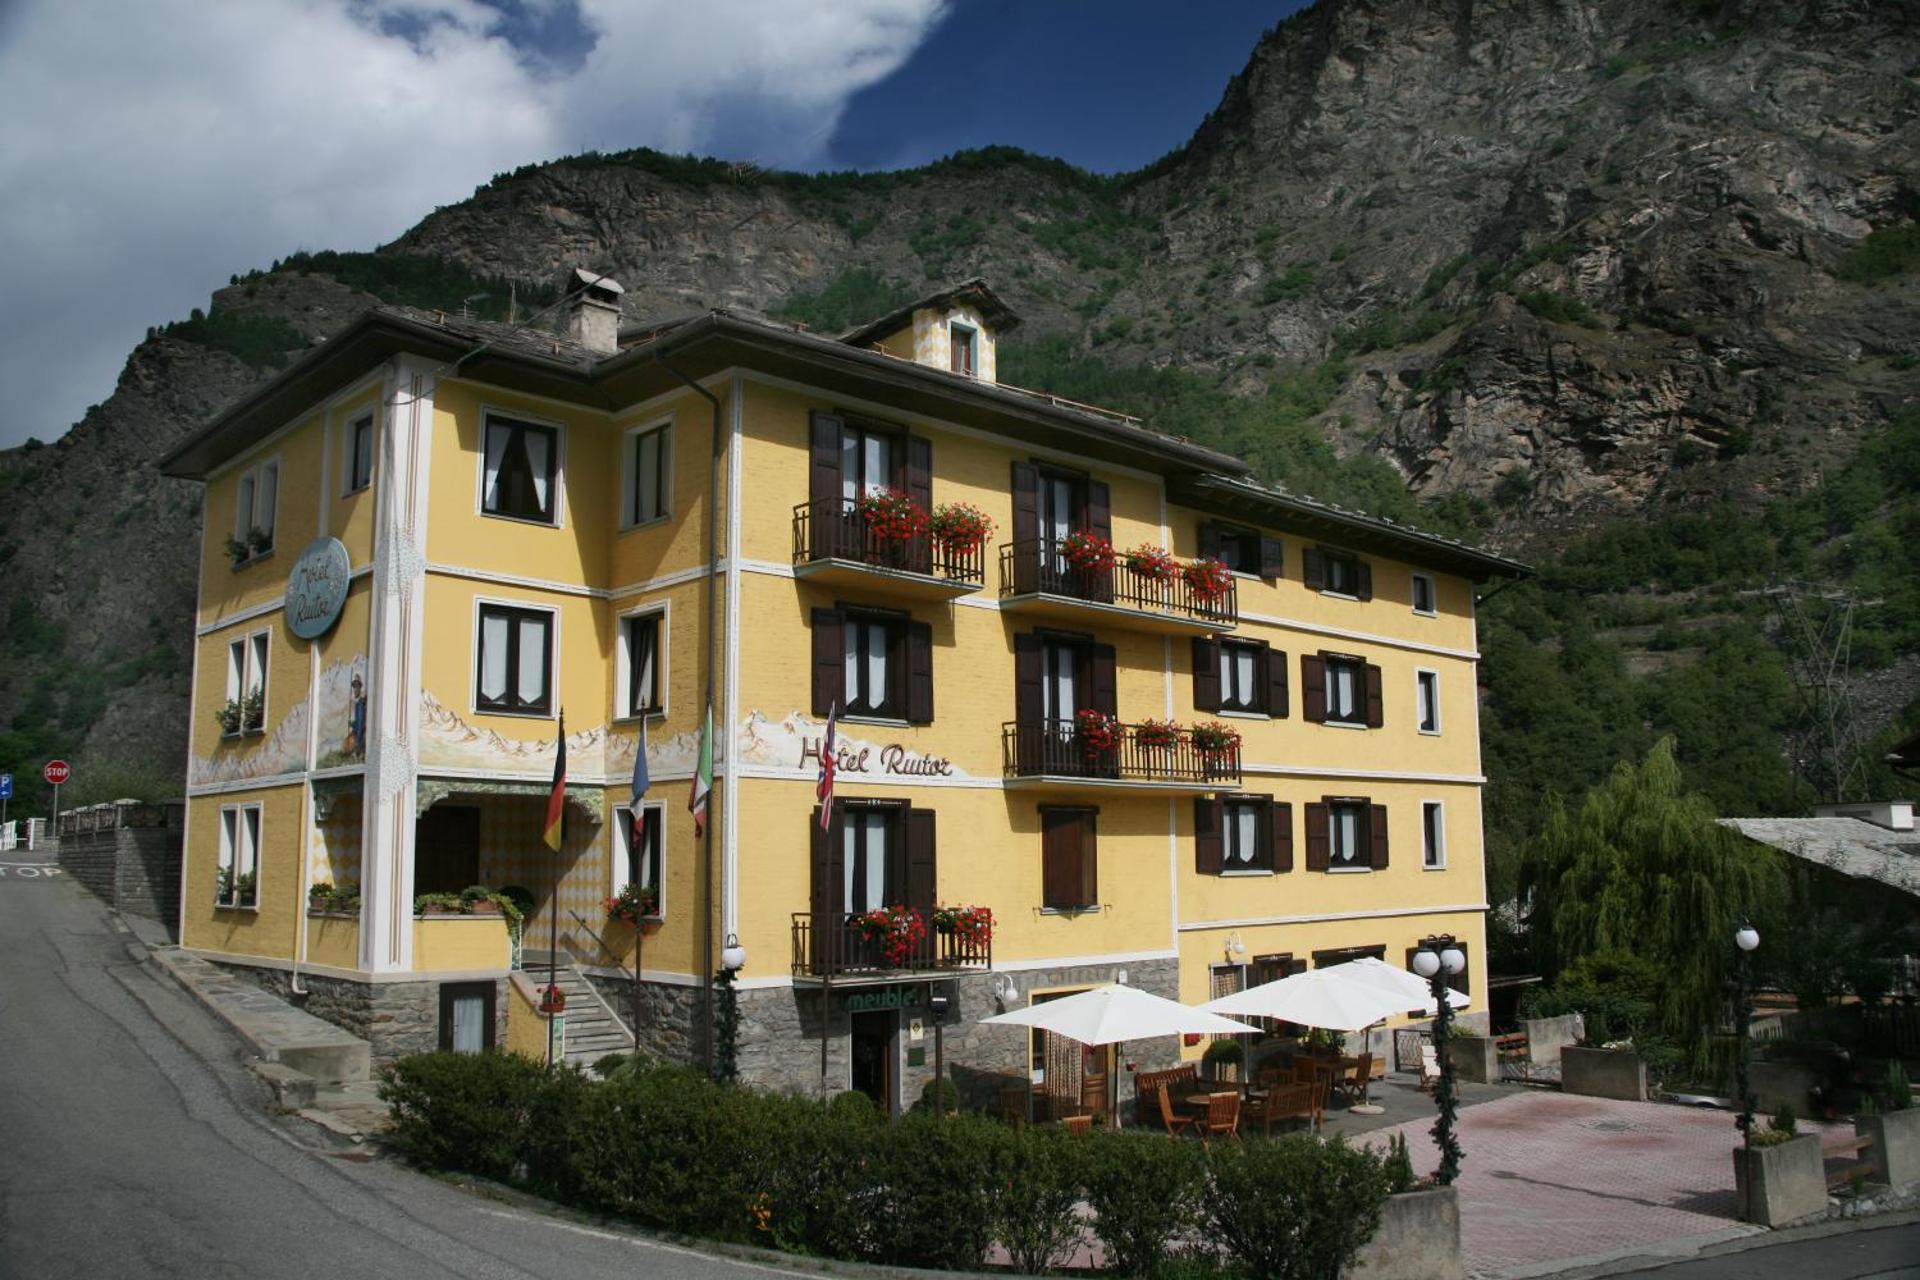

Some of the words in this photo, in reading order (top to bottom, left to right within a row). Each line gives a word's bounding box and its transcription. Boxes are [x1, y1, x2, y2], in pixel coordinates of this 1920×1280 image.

[799, 737, 870, 772] Htel
[880, 744, 953, 777] Ruitor
[46, 767, 69, 777] STOP
[1, 776, 10, 788] P
